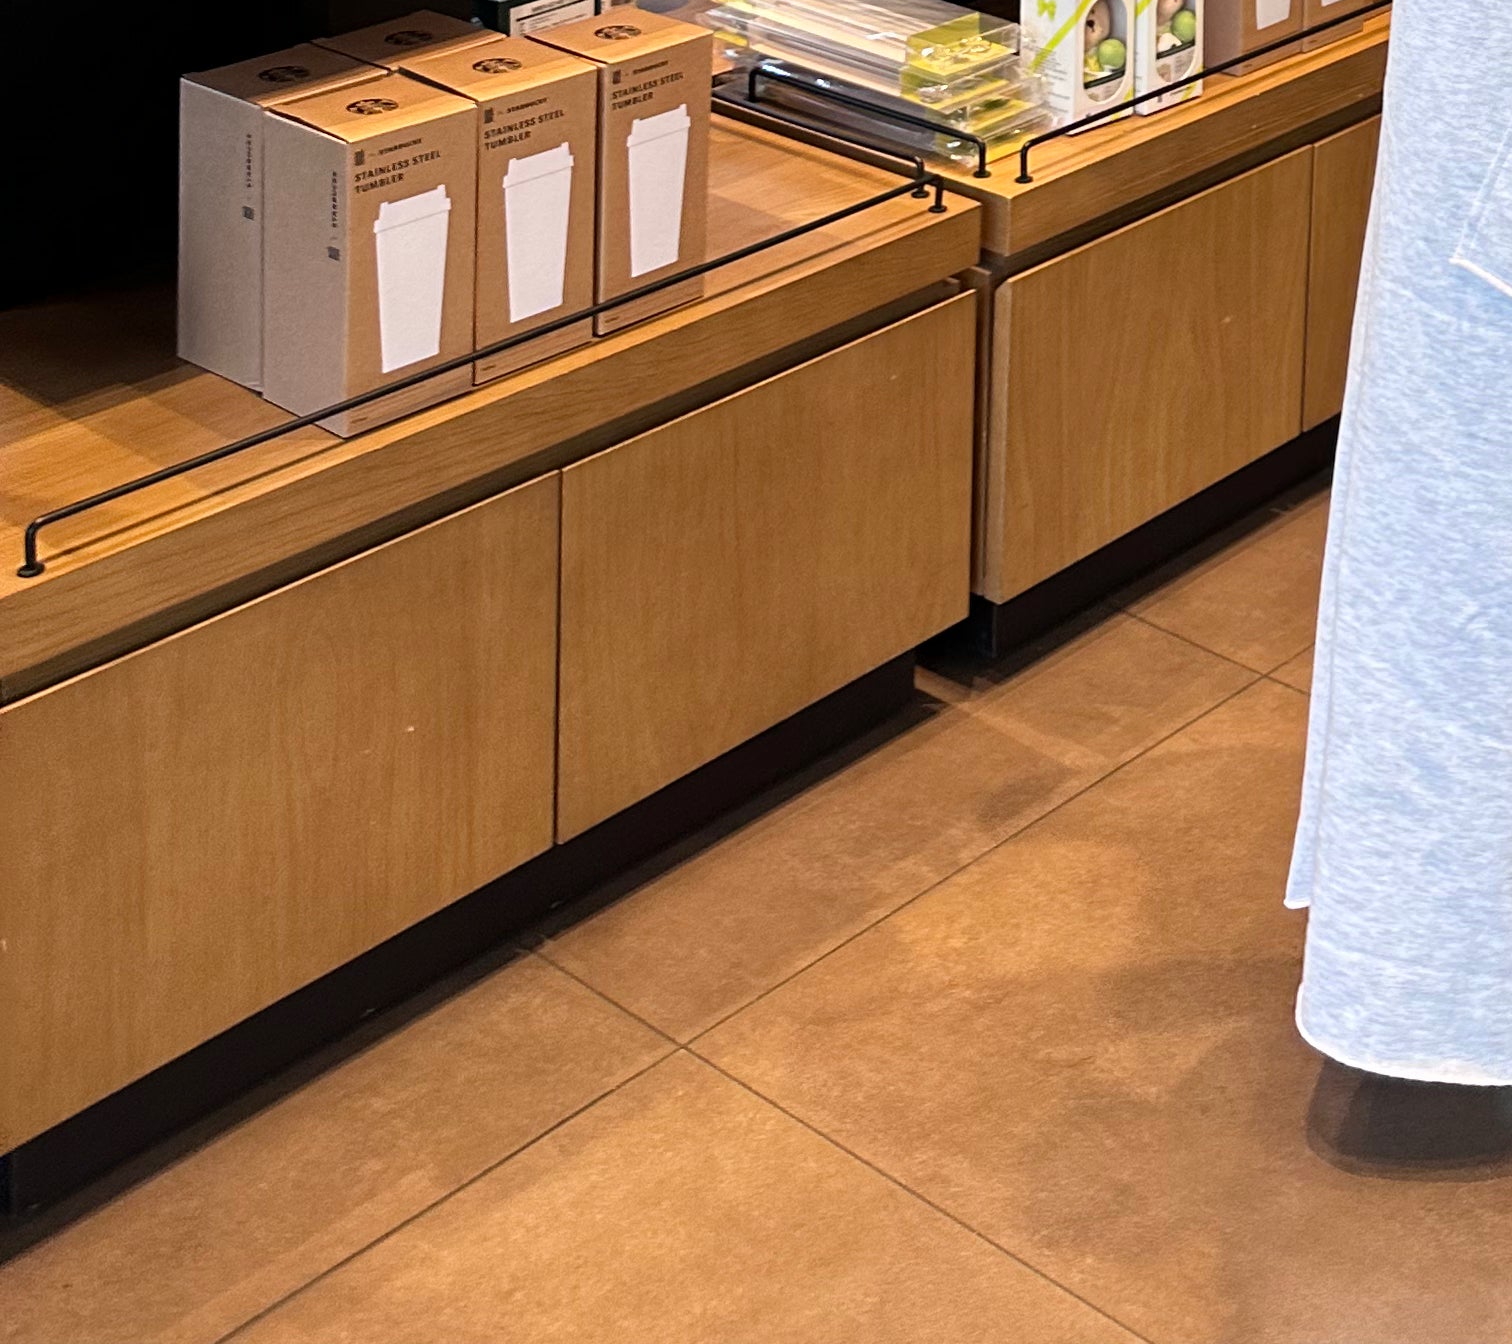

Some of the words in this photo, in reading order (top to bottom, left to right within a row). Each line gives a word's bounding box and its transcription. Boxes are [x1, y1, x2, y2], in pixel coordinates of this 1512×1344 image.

[612, 79, 658, 100] STAINLESS
[660, 71, 684, 86] STEEL
[612, 92, 653, 111] TUMBLER
[484, 117, 536, 140] STAINLESS
[538, 109, 565, 124] STEEL
[484, 130, 532, 151] TUMBLER
[354, 158, 410, 183] STAINLESS
[412, 150, 441, 166] STEEL
[354, 173, 405, 194] TUMBLER
